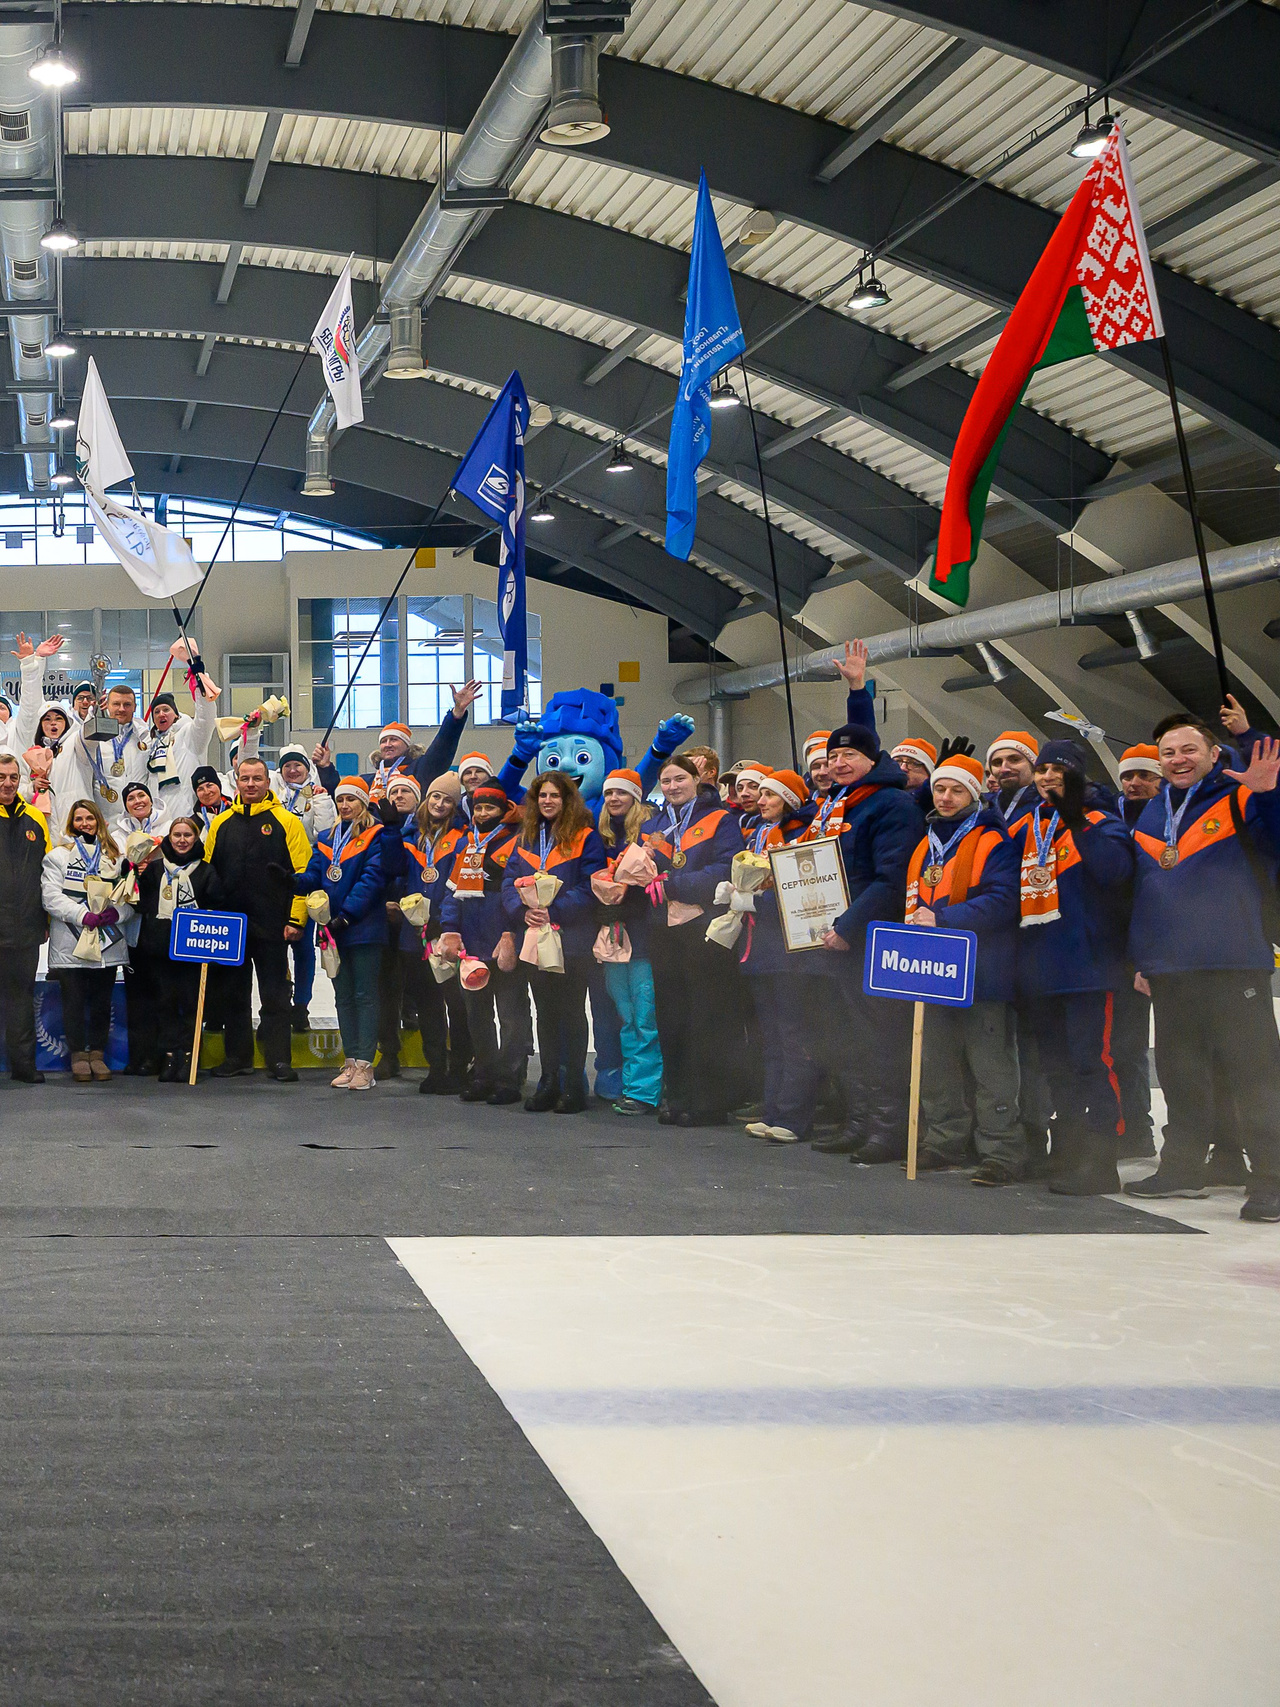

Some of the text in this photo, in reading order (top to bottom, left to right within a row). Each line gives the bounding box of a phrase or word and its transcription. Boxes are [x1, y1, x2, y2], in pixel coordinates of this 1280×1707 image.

[781, 873, 838, 891] СЕРТИФИКАТ
[190, 919, 229, 936] Белые
[186, 938, 230, 953] тигры
[881, 950, 958, 979] Молния
